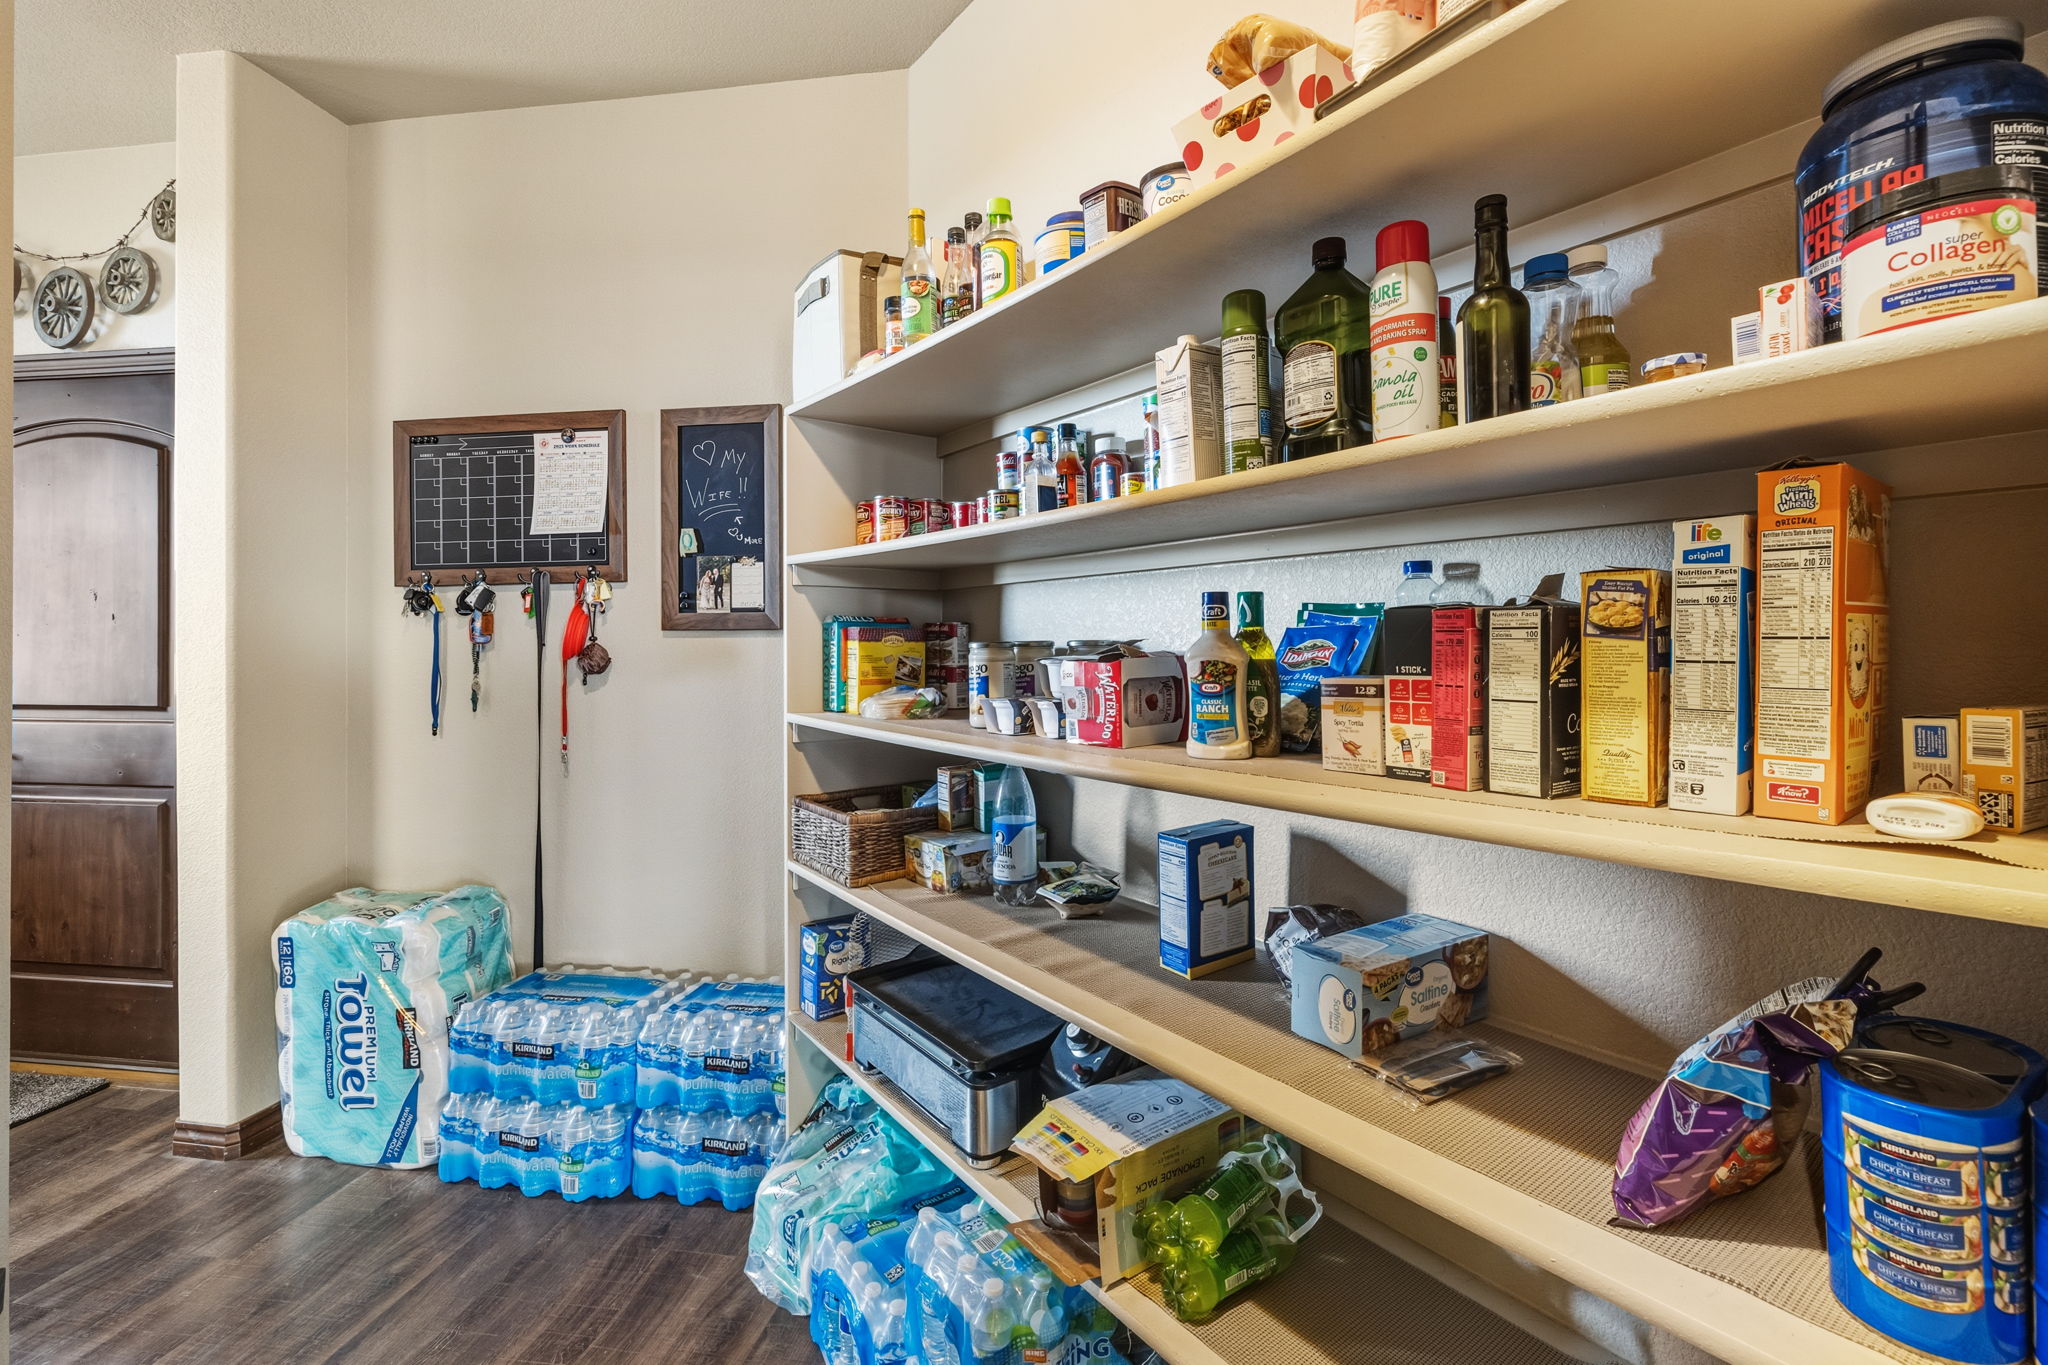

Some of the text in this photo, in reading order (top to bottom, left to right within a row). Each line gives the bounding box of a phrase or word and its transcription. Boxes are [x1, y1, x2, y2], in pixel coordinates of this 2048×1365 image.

[1994, 122, 2045, 135] Nutrition
[1995, 154, 2041, 165] Calories
[1803, 157, 1894, 208] BODYTECH
[1927, 207, 1976, 220] NEOCELL
[1887, 224, 1920, 238] COLLAGEN
[1887, 233, 1905, 244] TYPE
[1945, 231, 1983, 245] super
[1888, 239, 2006, 271] Collagen
[1370, 280, 1402, 305] PURE
[1886, 290, 1922, 303] CLINICALLY
[1923, 284, 1949, 293] TESTED
[1949, 279, 1979, 289] NEOCELL
[1377, 297, 1400, 310] simple
[1373, 319, 1416, 337] PERFORMANCE
[1382, 329, 1407, 341] BAKING
[1407, 328, 1428, 337] SPRAY
[1372, 369, 1418, 394] canola
[1393, 383, 1414, 401] oil
[721, 449, 746, 475] My
[1779, 474, 1815, 485] Kellogg's
[1781, 489, 1813, 504] Mini
[1785, 485, 1809, 493] Frosted
[1778, 499, 1815, 512] Wheats
[1775, 517, 1818, 528] ORIGINAL
[1691, 523, 1722, 542] life
[1688, 549, 1724, 561] original
[1804, 557, 1831, 566] 210 270
[1677, 568, 1712, 576] Nutrition
[1706, 595, 1720, 603] 160
[1722, 595, 1737, 603] 210
[1525, 630, 1539, 638] 100
[829, 638, 837, 709] TACO SHELLS
[1395, 665, 1422, 674] 1 STICK
[1354, 686, 1366, 695] 12
[1095, 665, 1120, 740] WATERLOO
[1196, 704, 1229, 714] RANCH
[1602, 748, 1632, 760] Quality
[281, 940, 292, 955] 12
[282, 960, 294, 985] 160
[1379, 973, 1400, 990] PACKS
[1410, 984, 1448, 1006] Saltine
[1333, 999, 1341, 1033] Saltine
[335, 971, 376, 1111] Towel
[364, 1005, 377, 1081] PREMIUM
[404, 1010, 420, 1067] KIRKLAND
[514, 1044, 553, 1055] KIRKLAND
[706, 1057, 749, 1069] KIRKLAND
[538, 1067, 571, 1080] water
[684, 1076, 768, 1094] purified water
[394, 1107, 410, 1138] WRAPPED
[394, 1113, 413, 1158] INDIVIDUALLY
[501, 1133, 538, 1147] KIRKLAND
[825, 1126, 853, 1148] KIRKLAND
[704, 1139, 746, 1151] KIRKLAND
[1881, 1141, 1935, 1162] KIRKLAND
[523, 1160, 555, 1172] water
[683, 1163, 764, 1178] purified water
[1869, 1156, 1910, 1179] CHICKEN
[1912, 1170, 1951, 1187] BREAST
[1135, 1155, 1205, 1195] LEMONADE PACK
[914, 1186, 961, 1211] KIRKLAND
[1884, 1196, 1939, 1218] KIRKLAND
[1873, 1209, 1954, 1242] CHICKEN BREAST
[1888, 1250, 1942, 1273] KIRKLAND
[1877, 1262, 1957, 1296] CHICKEN BREAST
